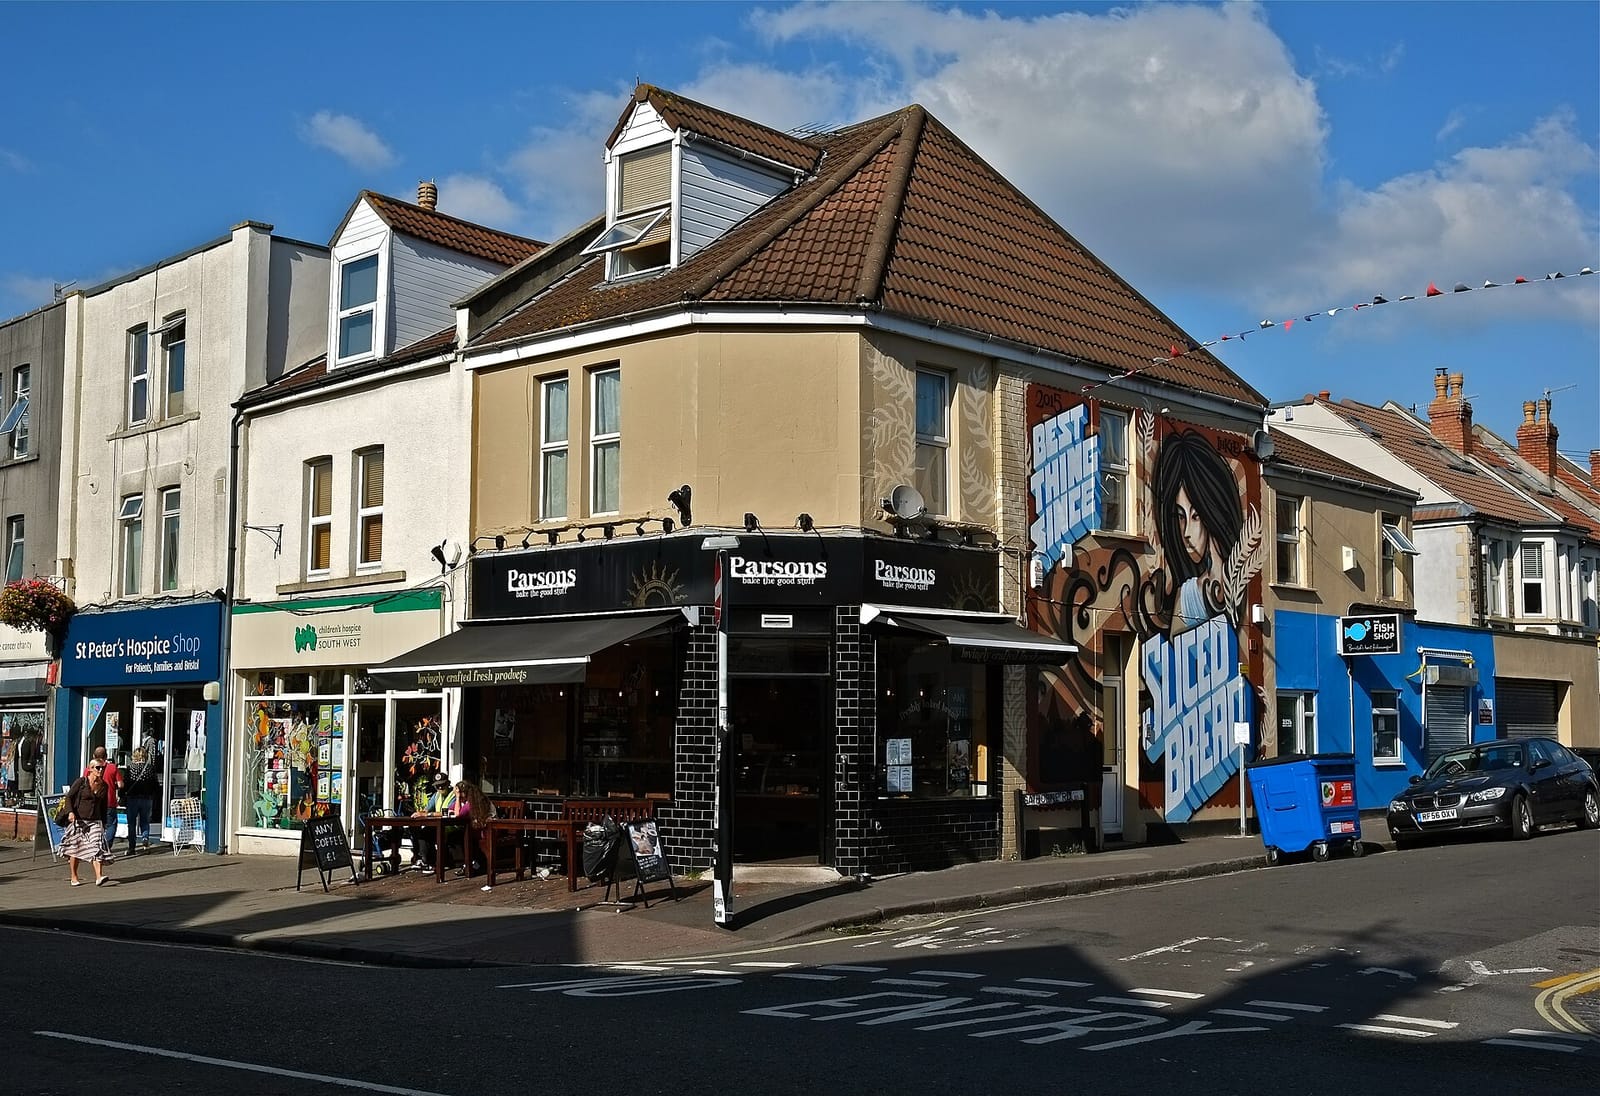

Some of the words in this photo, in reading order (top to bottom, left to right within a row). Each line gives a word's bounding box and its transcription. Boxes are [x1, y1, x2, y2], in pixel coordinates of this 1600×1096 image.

[1036, 390, 1062, 411] 2015
[1033, 403, 1088, 468] BEST
[1031, 435, 1098, 516] THING
[1031, 476, 1097, 552] SINCE
[730, 557, 827, 578] Parsons
[875, 560, 936, 585] Parsons
[508, 569, 577, 591] Parsons
[742, 576, 760, 585] bake
[763, 577, 775, 585] the
[777, 577, 795, 586] good
[797, 577, 815, 586] stuff
[904, 581, 917, 590] good
[530, 588, 539, 598] the
[540, 586, 553, 598] good
[319, 624, 341, 634] children's
[342, 624, 361, 634] hospice
[1373, 623, 1395, 633] FISH
[1373, 632, 1395, 640] SHOP
[17, 641, 32, 651] charity
[75, 642, 86, 659] St
[89, 638, 124, 659] Peter's
[127, 635, 170, 660] Hospice
[173, 633, 200, 656] Shop
[318, 640, 341, 649] SOUTH
[343, 638, 361, 647] WEST
[125, 663, 133, 673] For
[133, 662, 153, 674] Patients,
[154, 661, 173, 672] Families
[174, 660, 183, 671] and
[184, 659, 199, 671] Bristol
[417, 671, 445, 686] lovingly
[447, 670, 472, 685] crafted
[473, 669, 493, 682] fresh
[494, 668, 527, 684] products
[1142, 613, 1230, 750] SLICED
[1165, 675, 1245, 816] BREAD
[1422, 811, 1440, 821] RF56
[315, 823, 333, 836] ANY
[315, 835, 344, 849] COFFEE
[738, 991, 1272, 1051] ENTRY
